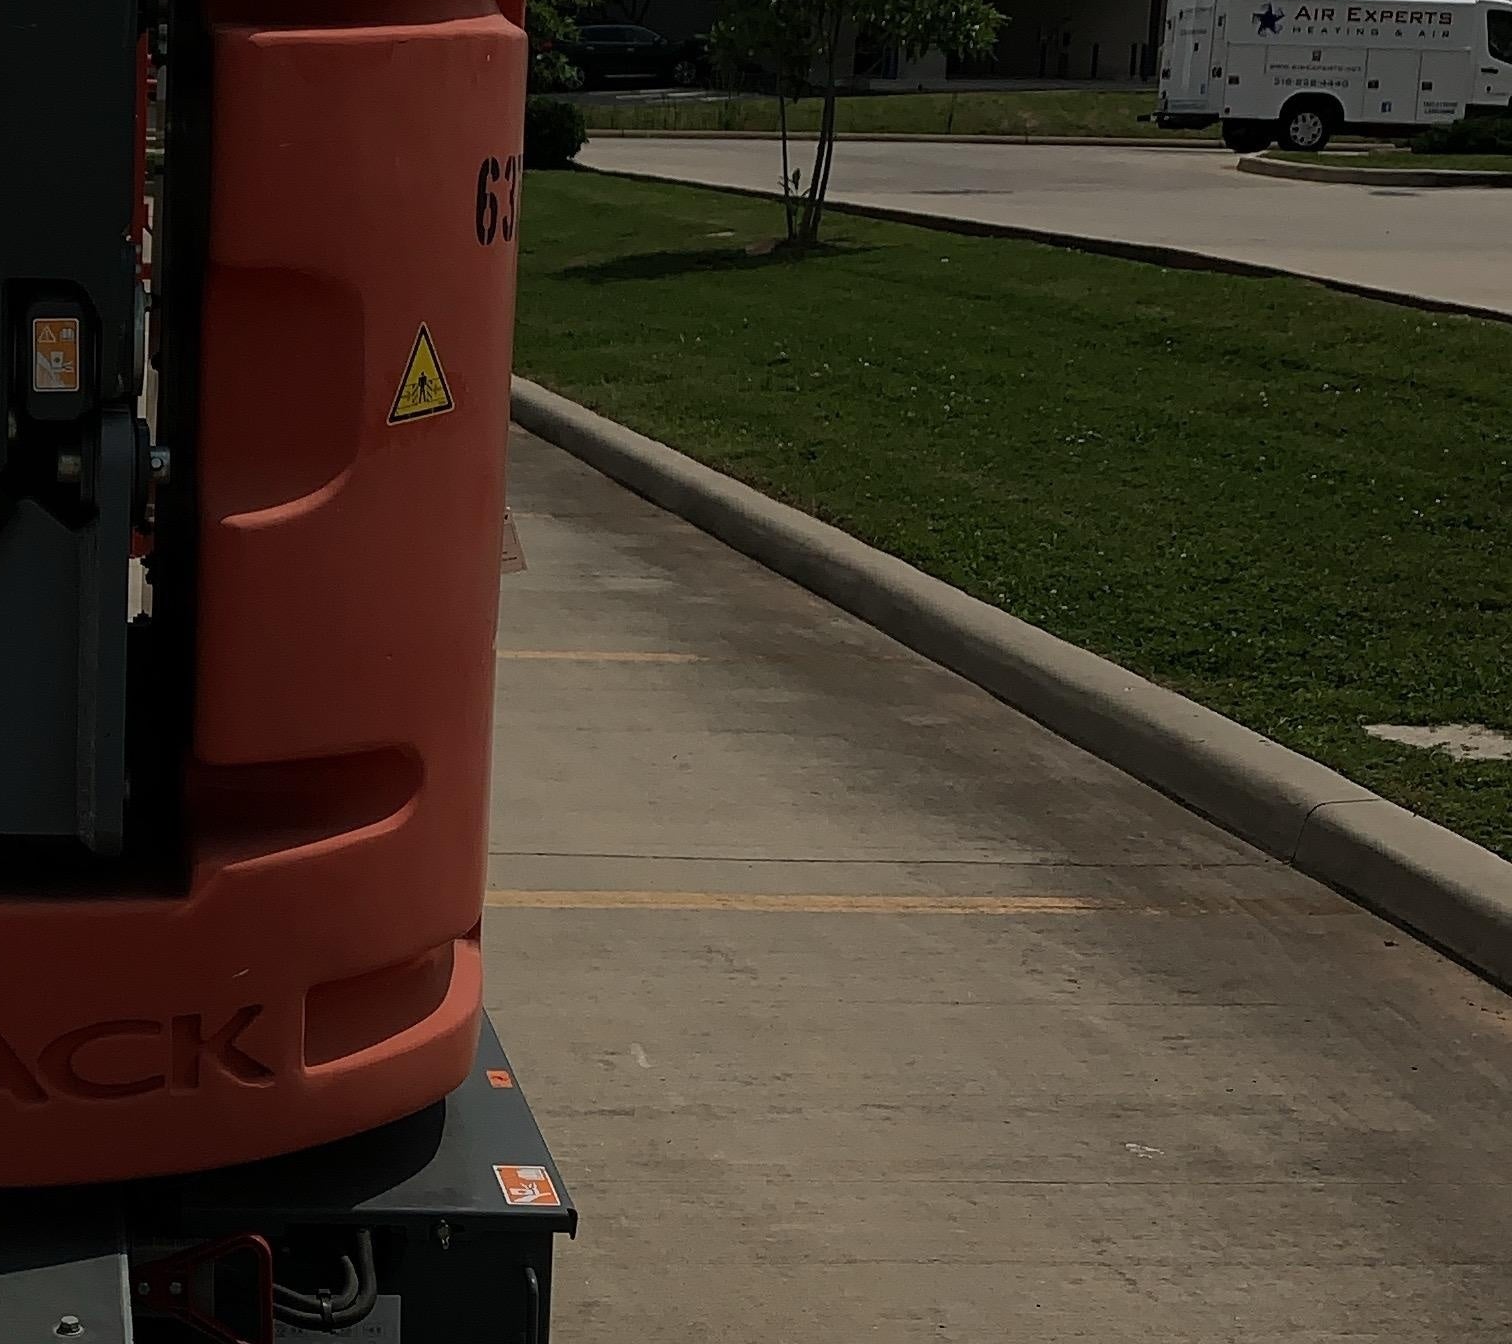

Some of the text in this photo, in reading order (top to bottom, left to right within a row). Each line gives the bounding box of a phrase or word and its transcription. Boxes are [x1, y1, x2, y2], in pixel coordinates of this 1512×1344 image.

[1295, 6, 1453, 25] AIR EXPERTS
[1292, 26, 1379, 37] HEATING
[1418, 29, 1450, 39] AIR
[476, 155, 522, 246] 63
